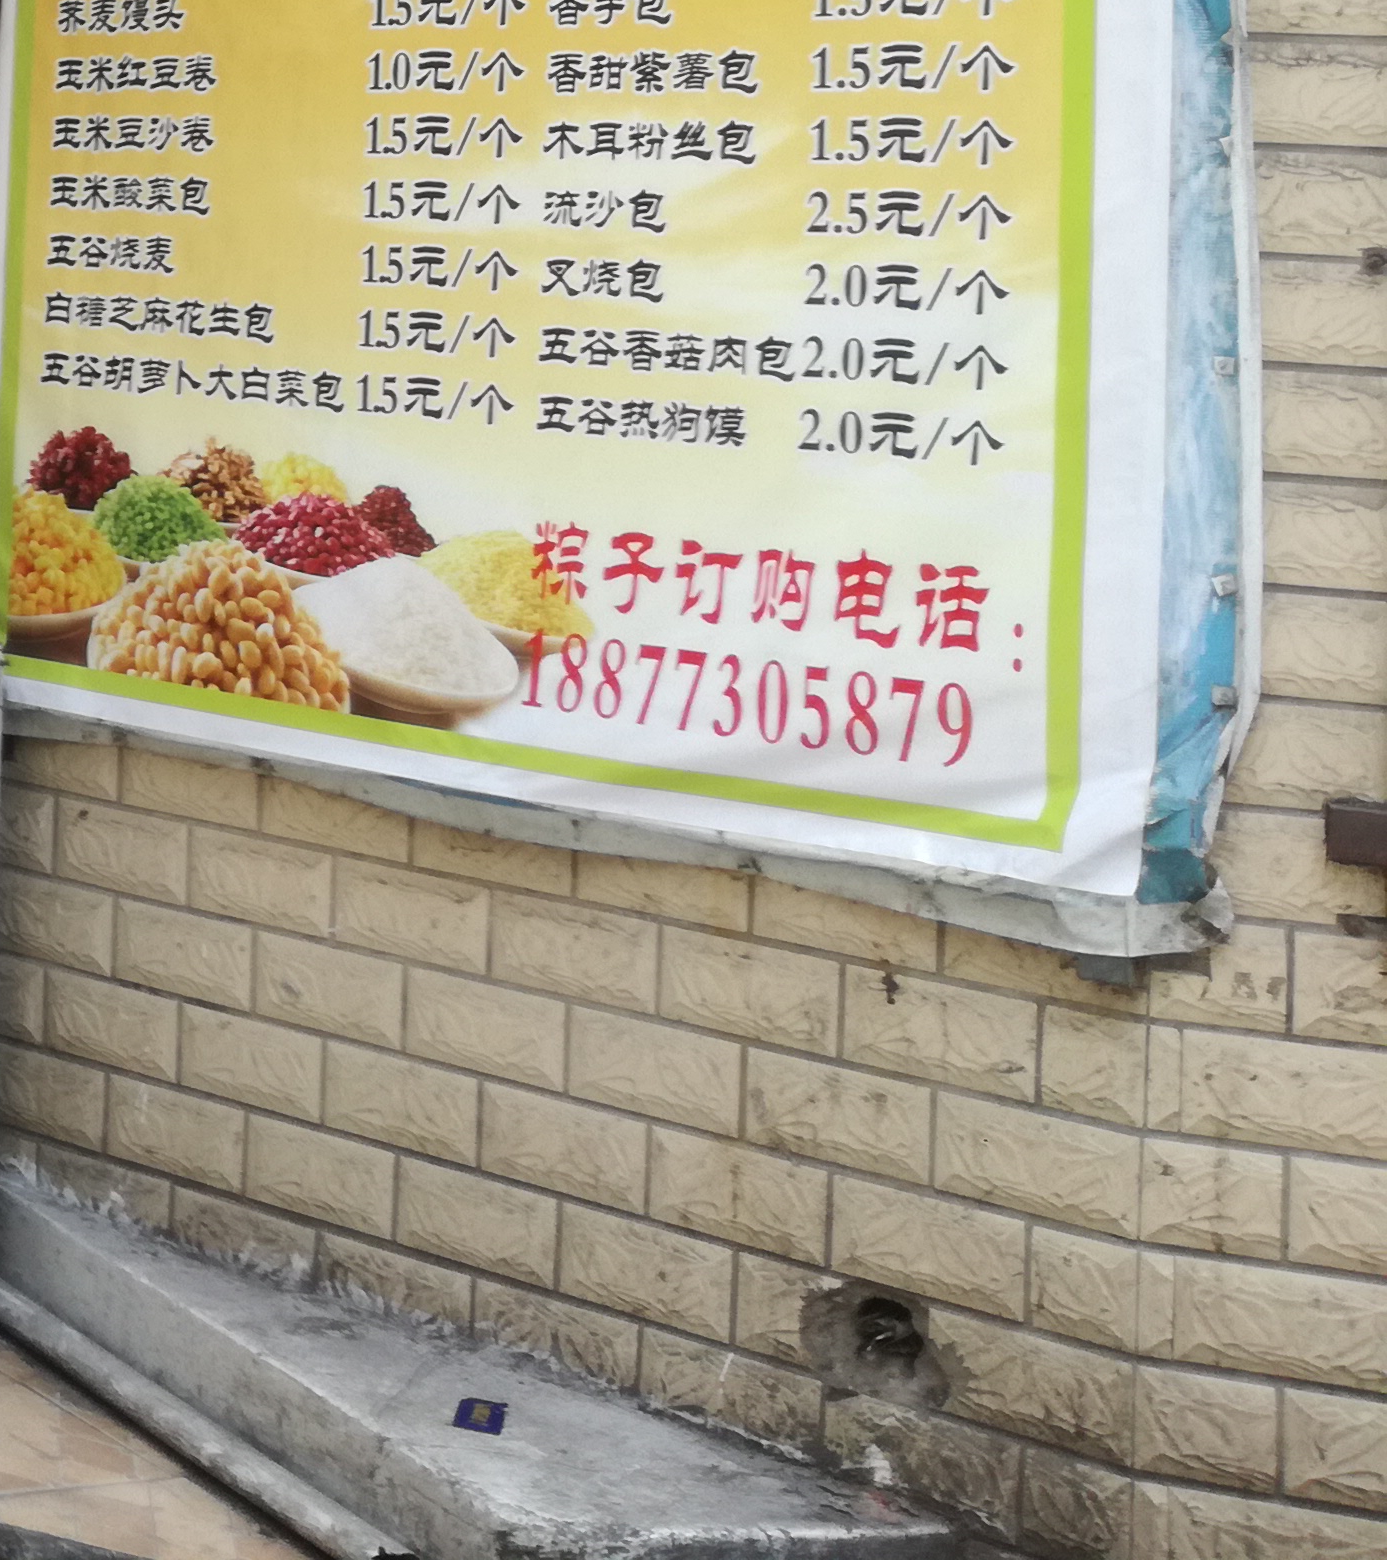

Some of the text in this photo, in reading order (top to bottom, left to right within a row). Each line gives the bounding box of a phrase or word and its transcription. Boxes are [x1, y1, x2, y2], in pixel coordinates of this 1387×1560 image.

[55, 51, 524, 92] 玉米红豆卷 1.0元/个
[548, 44, 1014, 93] 香甜紫薯包 1.5元/个
[53, 116, 523, 157] 玉米豆沙卷 1.5元/个
[543, 117, 1013, 165] 木耳粉丝包 1.5元/个
[50, 175, 520, 224] 玉米酸菜包 1.5元/个
[543, 189, 1011, 239] 流沙包 2.5元/个
[46, 235, 518, 290] 五谷烧麦 1.5元/个
[541, 259, 1010, 315] 叉烧包 2.0元/个
[44, 292, 516, 357] 白糖芝麻花生包 1.5元/个
[539, 328, 1008, 390] 五谷香菇肉包 2.0元/个
[40, 353, 514, 424] 五谷胡萝卜大白菜包 1.5元/个
[537, 397, 1005, 465] 五谷热狗馍 2.0元/个
[521, 627, 973, 768] 18877305879
